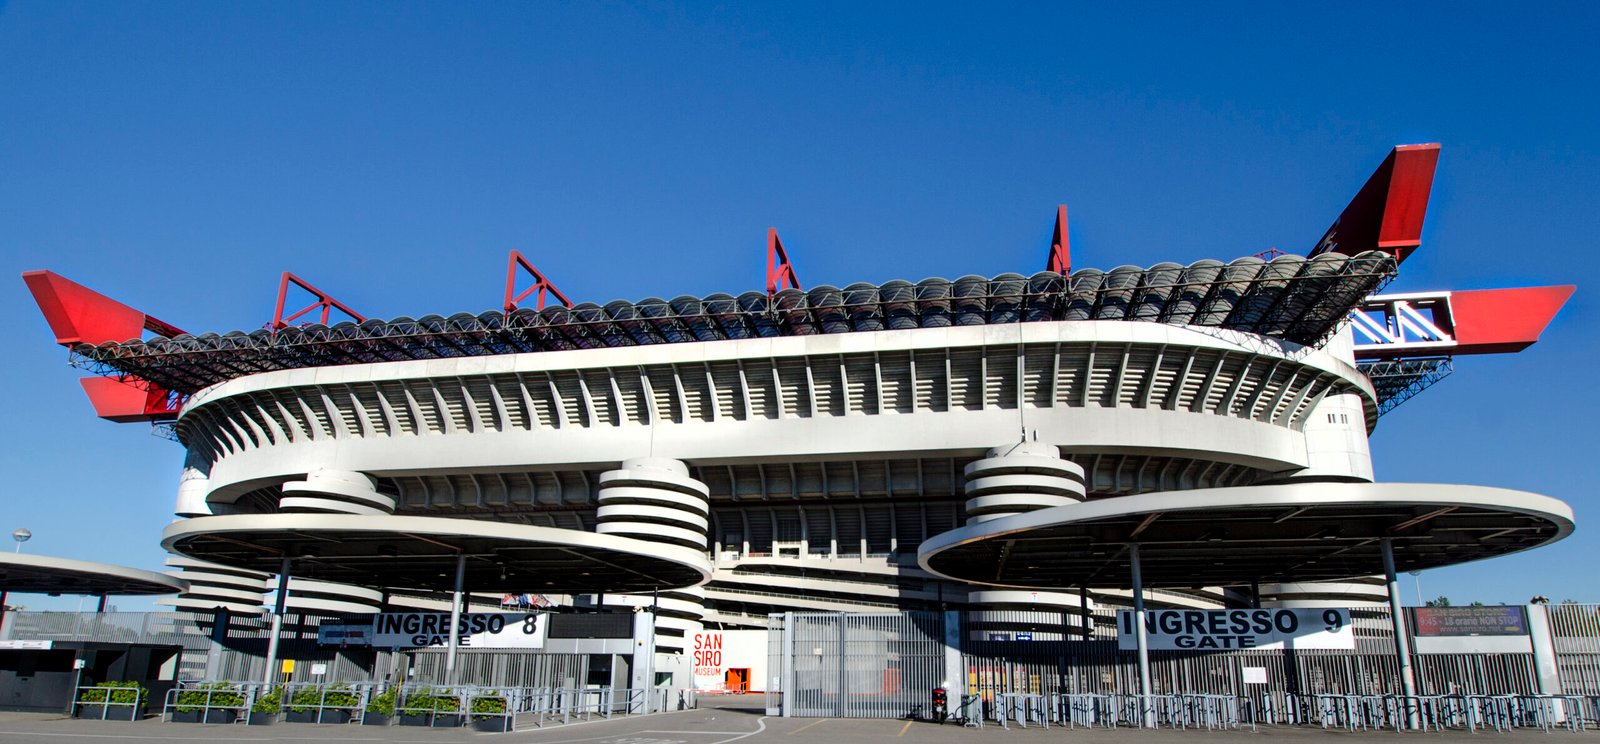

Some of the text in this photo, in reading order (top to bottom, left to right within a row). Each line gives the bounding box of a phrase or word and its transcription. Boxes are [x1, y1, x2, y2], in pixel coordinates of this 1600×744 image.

[376, 613, 537, 635] INGRESSO 8
[1123, 609, 1343, 635] INGRESSO 9
[1445, 617, 1454, 626] 18
[1455, 617, 1478, 626] orario
[1479, 616, 1498, 625] NON
[1499, 616, 1518, 625] STOP
[411, 635, 471, 647] GAE
[694, 633, 722, 650] SAN
[1174, 635, 1257, 649] GATE
[694, 650, 722, 667] SIRO
